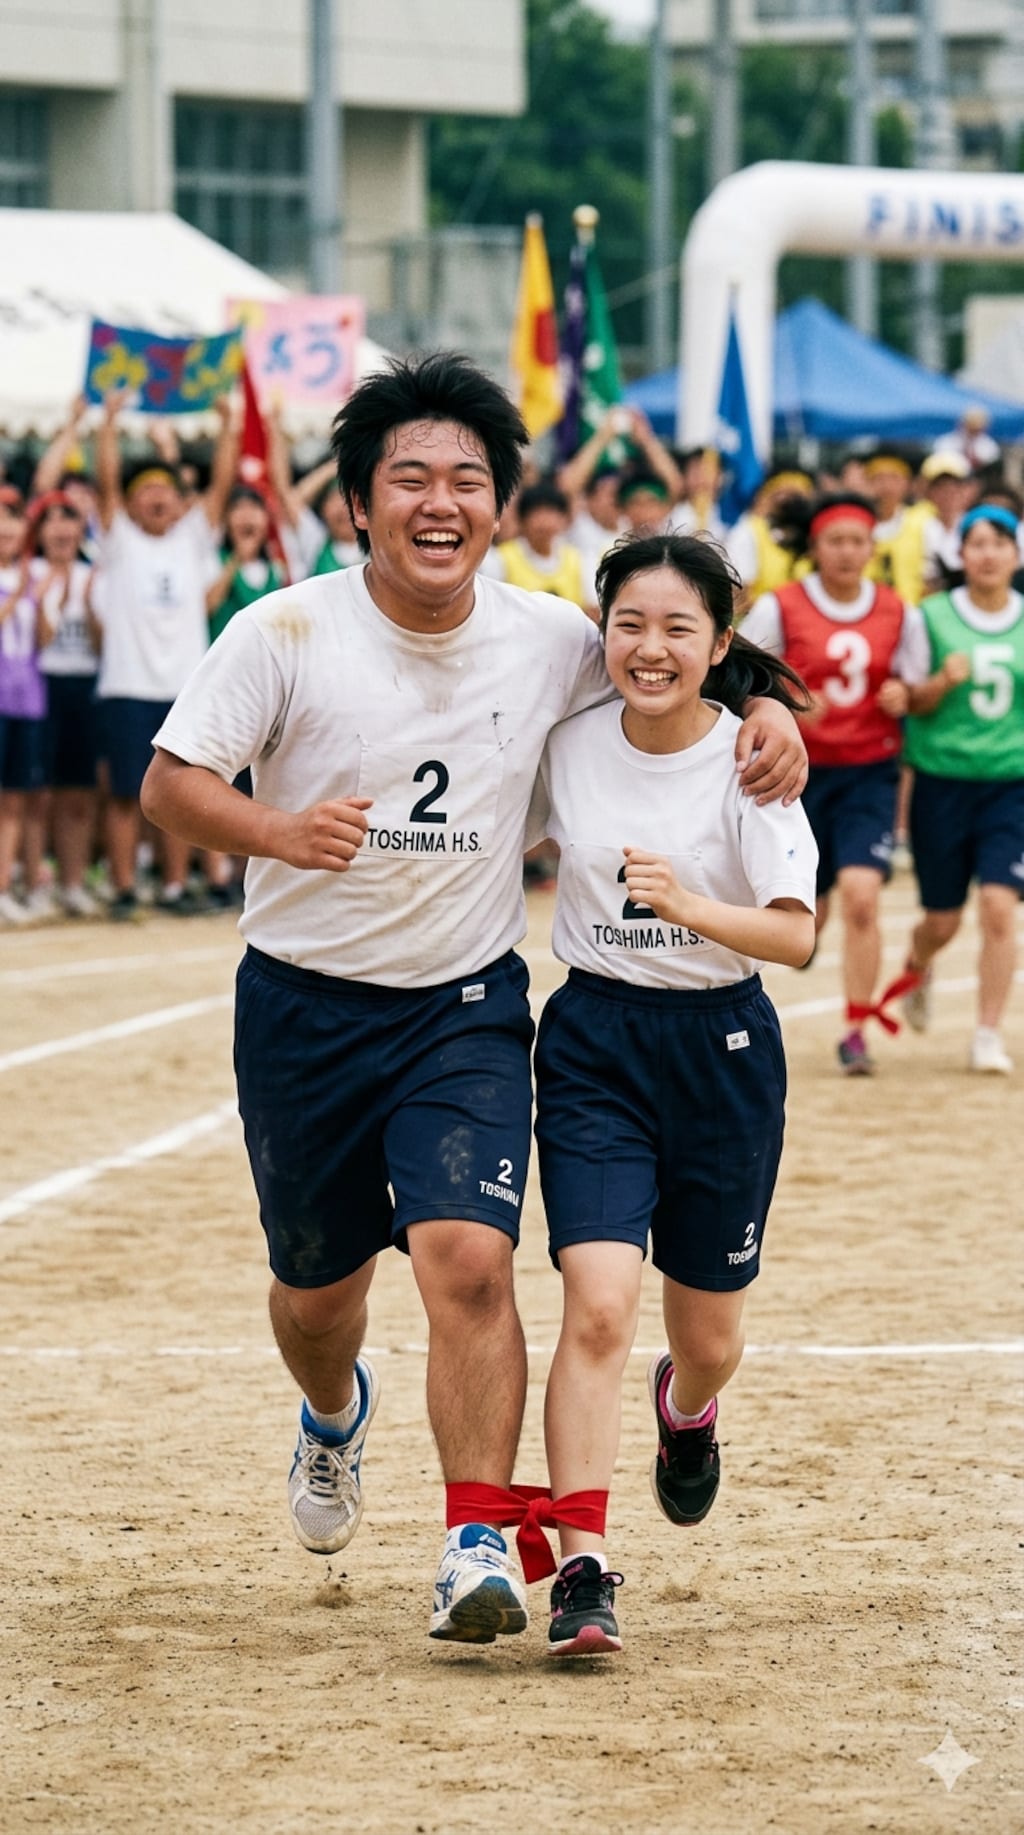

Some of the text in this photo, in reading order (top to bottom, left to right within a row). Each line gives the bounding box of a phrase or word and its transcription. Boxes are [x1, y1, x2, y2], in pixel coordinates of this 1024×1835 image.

[824, 630, 871, 708] 3
[969, 643, 1015, 720] 5
[409, 760, 449, 824] 2
[368, 828, 482, 852] TOSHIMA H.S.
[593, 925, 665, 949] TOSHIMA
[497, 1158, 513, 1185] 2
[743, 1222, 755, 1248] 2
